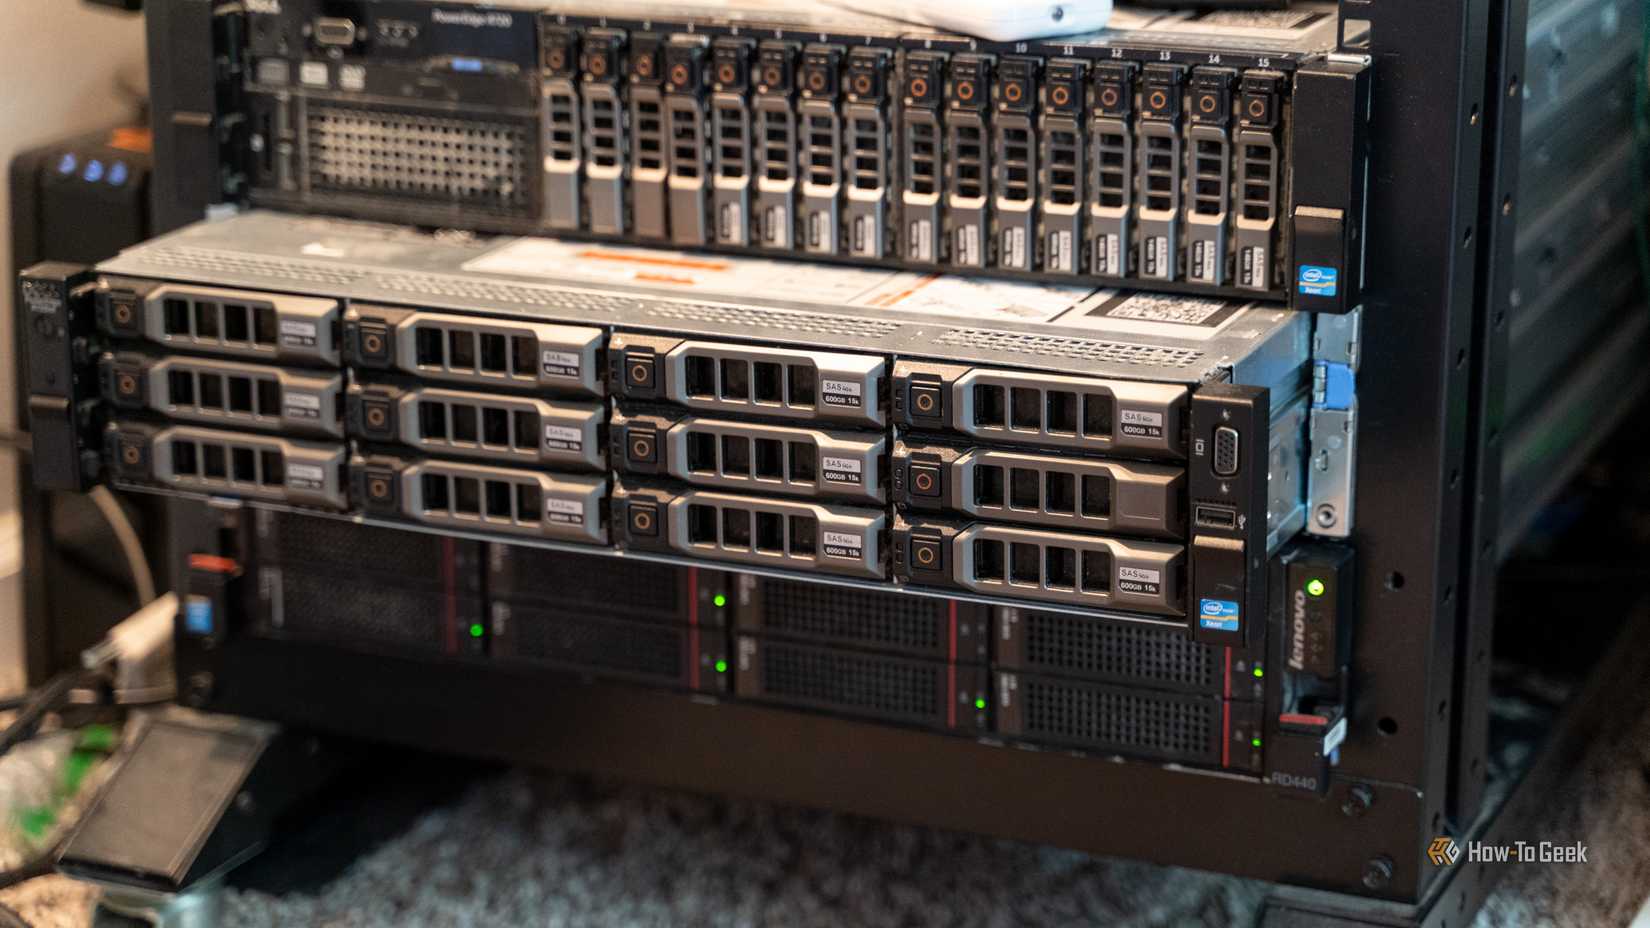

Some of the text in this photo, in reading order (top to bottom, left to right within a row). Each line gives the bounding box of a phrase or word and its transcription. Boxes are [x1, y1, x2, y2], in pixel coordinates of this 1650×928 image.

[1015, 43, 1028, 53] 10
[1063, 46, 1073, 55] 11
[1111, 48, 1122, 58] 12
[1160, 52, 1170, 60] 13
[1208, 54, 1220, 64] 14
[1258, 58, 1270, 67] 15
[825, 394, 846, 404] 600GB
[1120, 581, 1142, 591] 600GB
[1288, 589, 1305, 670] lenovo
[1272, 771, 1317, 791] RD440
